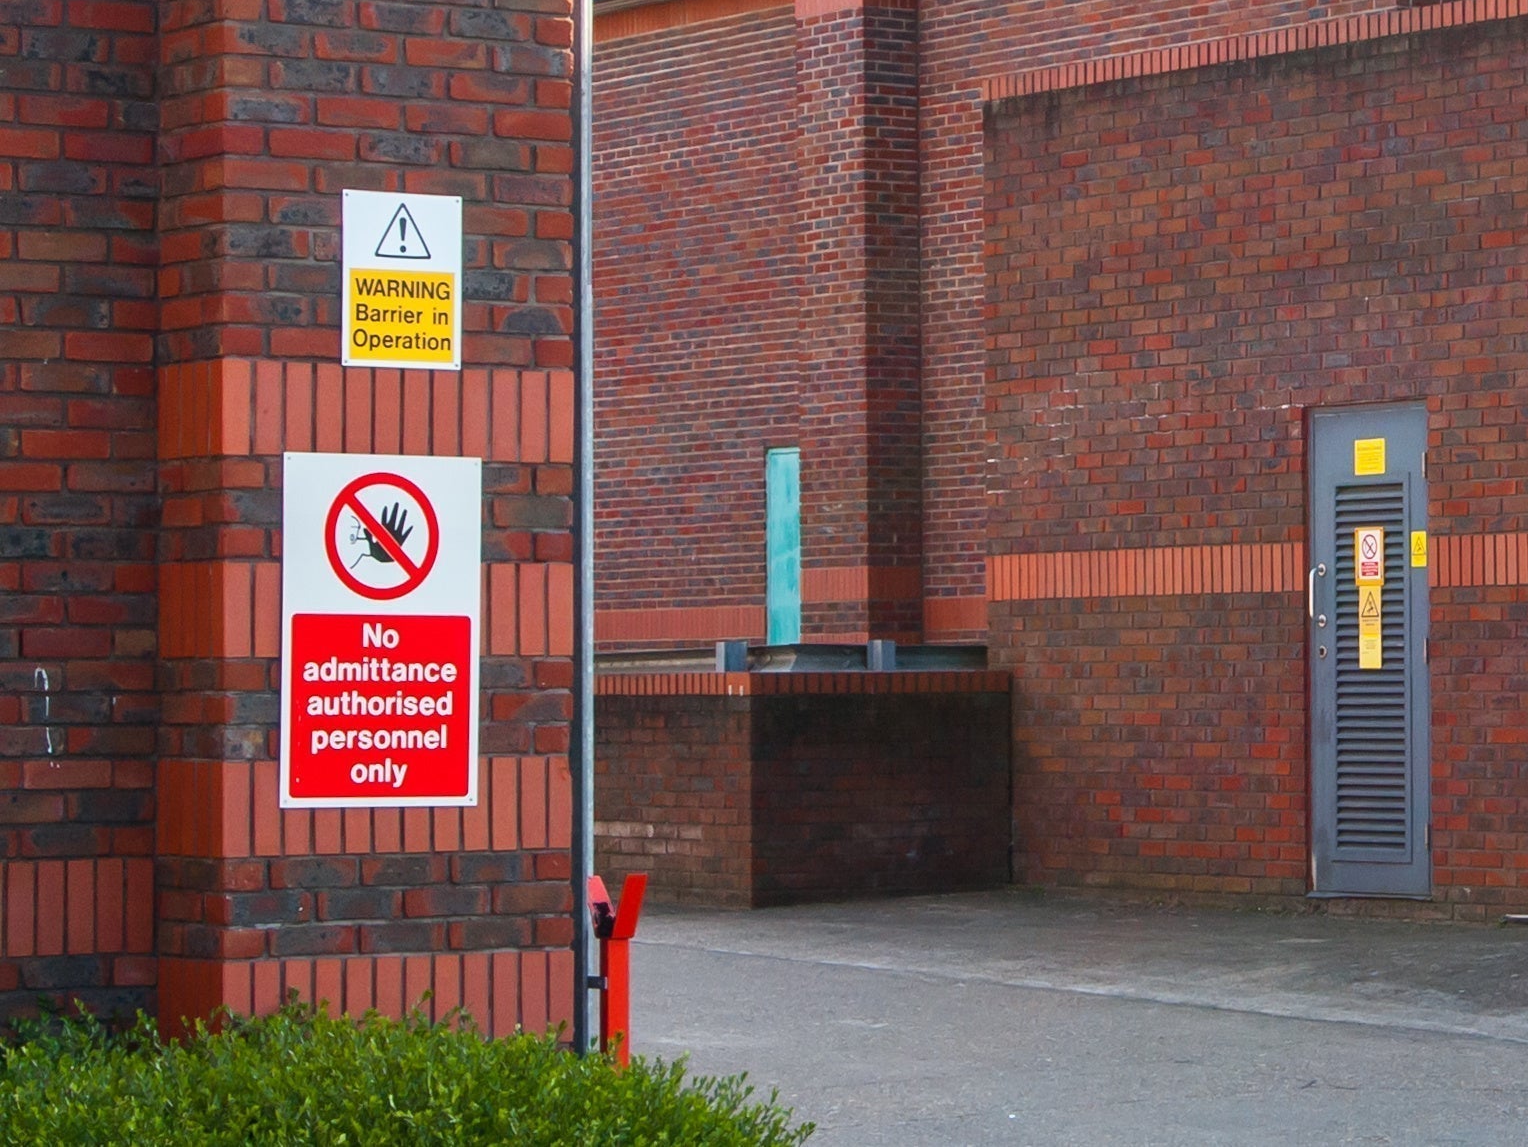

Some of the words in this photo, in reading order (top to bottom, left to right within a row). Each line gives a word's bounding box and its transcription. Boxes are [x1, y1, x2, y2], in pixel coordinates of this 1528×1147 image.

[355, 277, 451, 300] WARNING
[355, 303, 423, 324] Barrier
[432, 307, 449, 325] in
[353, 328, 452, 351] Operation
[362, 622, 400, 650] No
[303, 657, 458, 683] admittance
[306, 691, 454, 716] authorised
[310, 724, 447, 754] personnel
[350, 758, 408, 787] only
